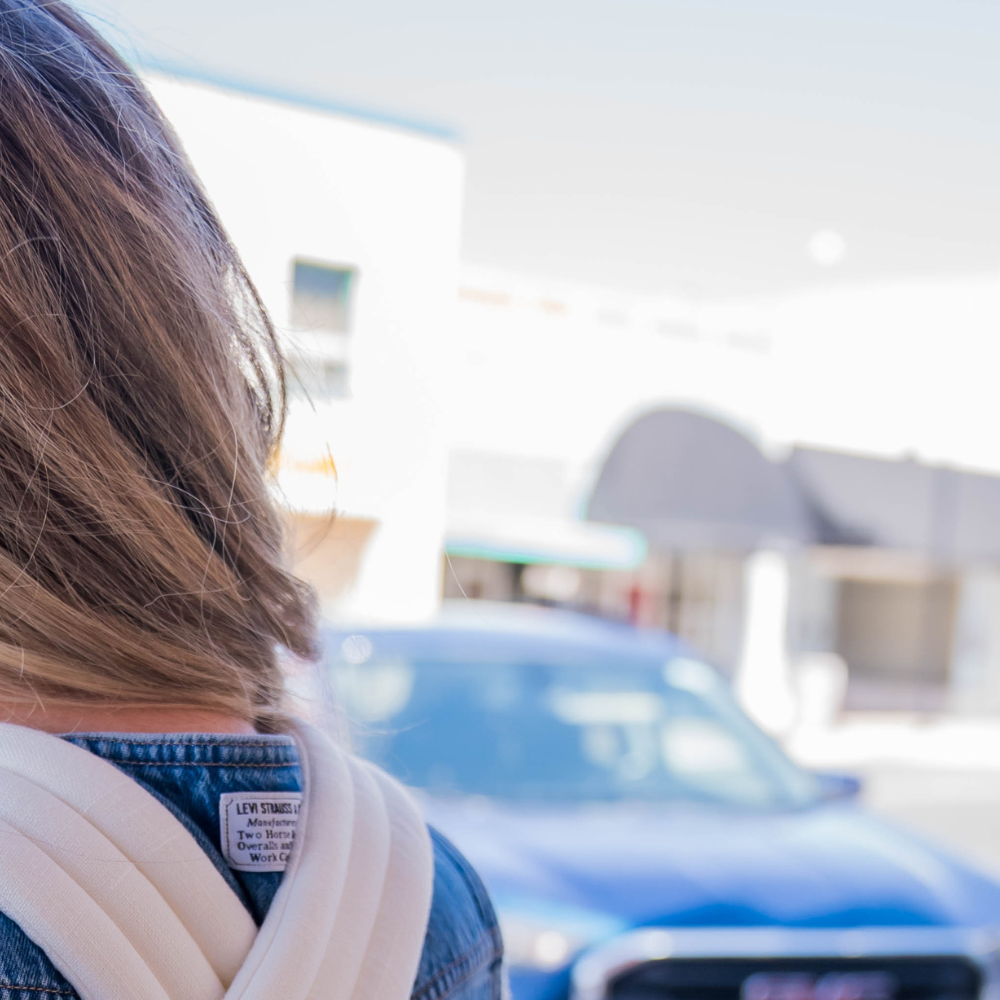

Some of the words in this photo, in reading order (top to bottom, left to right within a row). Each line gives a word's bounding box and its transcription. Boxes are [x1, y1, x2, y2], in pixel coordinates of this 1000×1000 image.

[236, 803, 258, 815] LEVI
[261, 802, 292, 815] STRAUSS
[237, 830, 262, 839] Two
[265, 829, 290, 839] Horse
[237, 841, 278, 851] Overalls
[249, 853, 277, 862] Work
